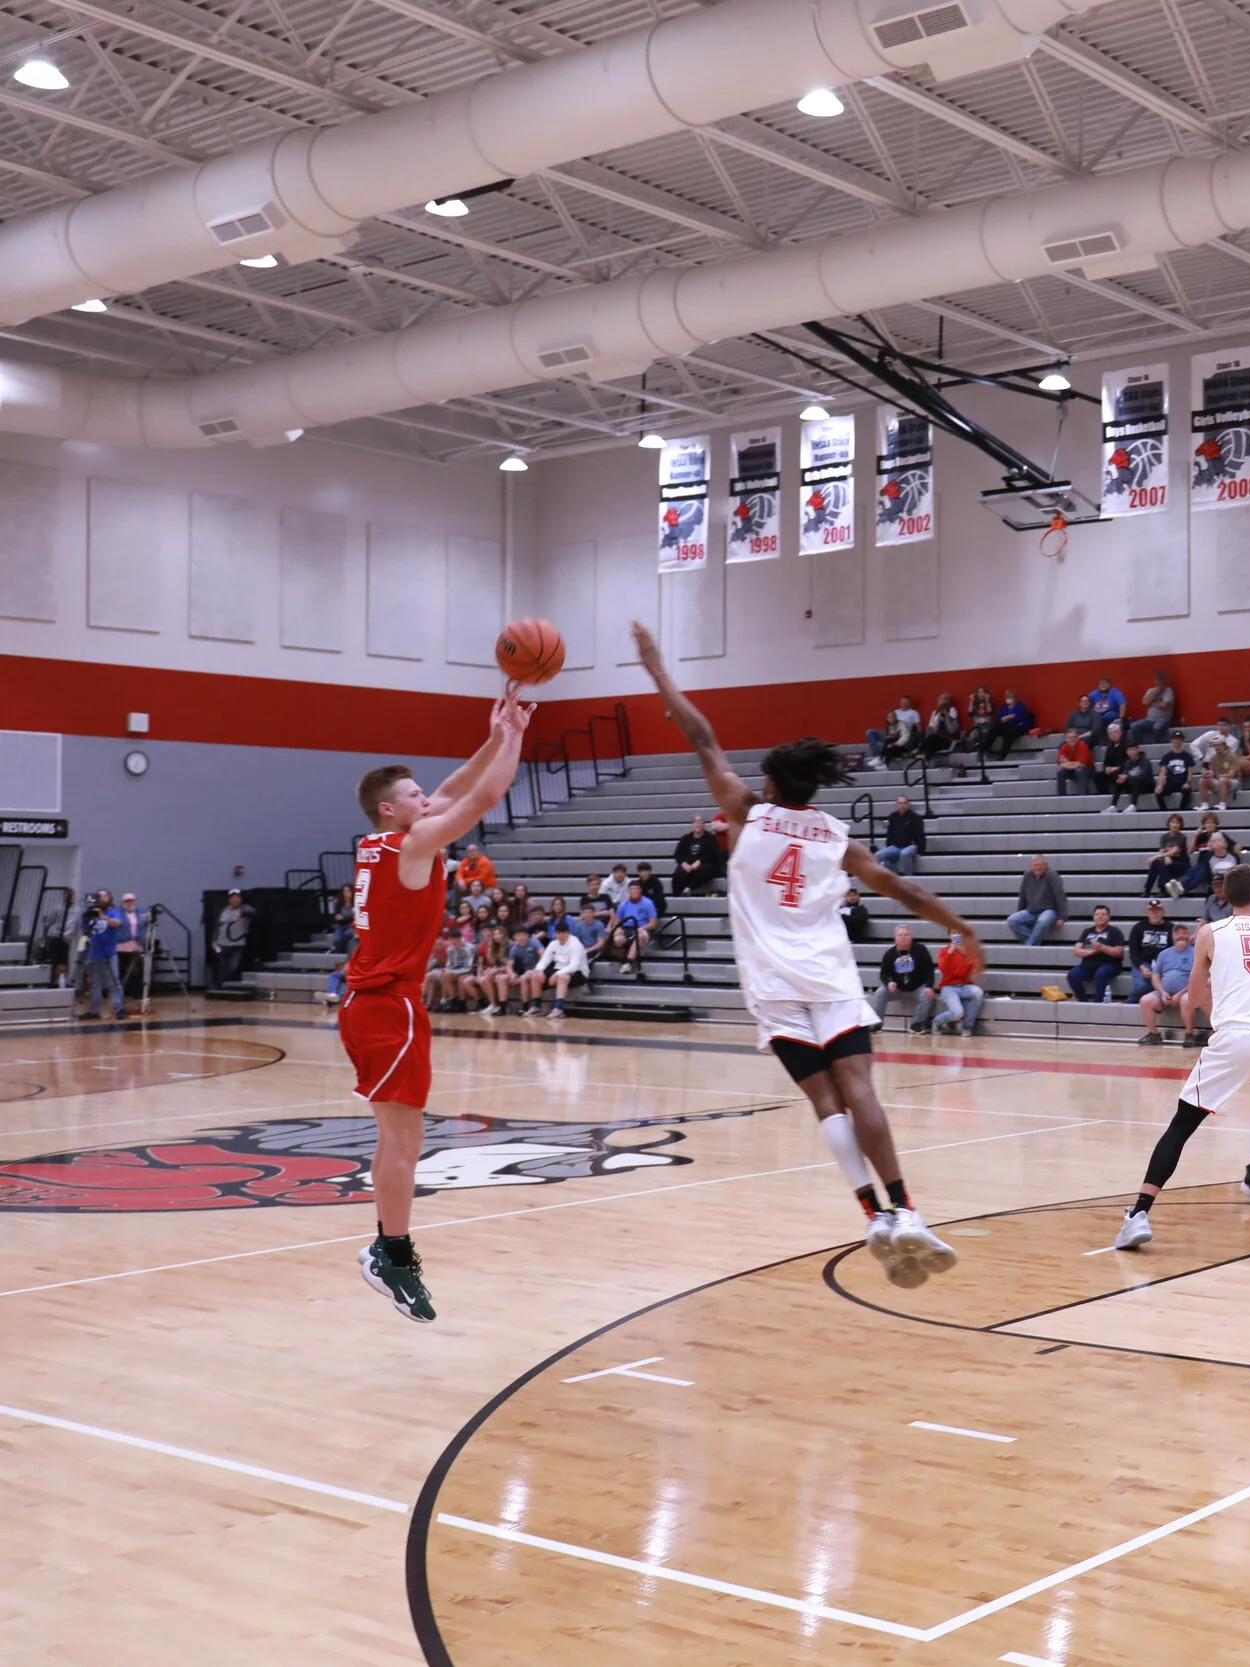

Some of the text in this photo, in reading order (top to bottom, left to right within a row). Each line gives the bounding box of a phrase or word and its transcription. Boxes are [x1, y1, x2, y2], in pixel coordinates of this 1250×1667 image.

[1194, 416, 1215, 427] Girls
[1129, 486, 1166, 508] 2007
[823, 525, 851, 544] 2001
[898, 514, 930, 536] 2002
[749, 536, 777, 553] 1998
[3, 821, 56, 834] RESTROOMS
[764, 843, 807, 908] 4
[354, 868, 371, 930] 2
